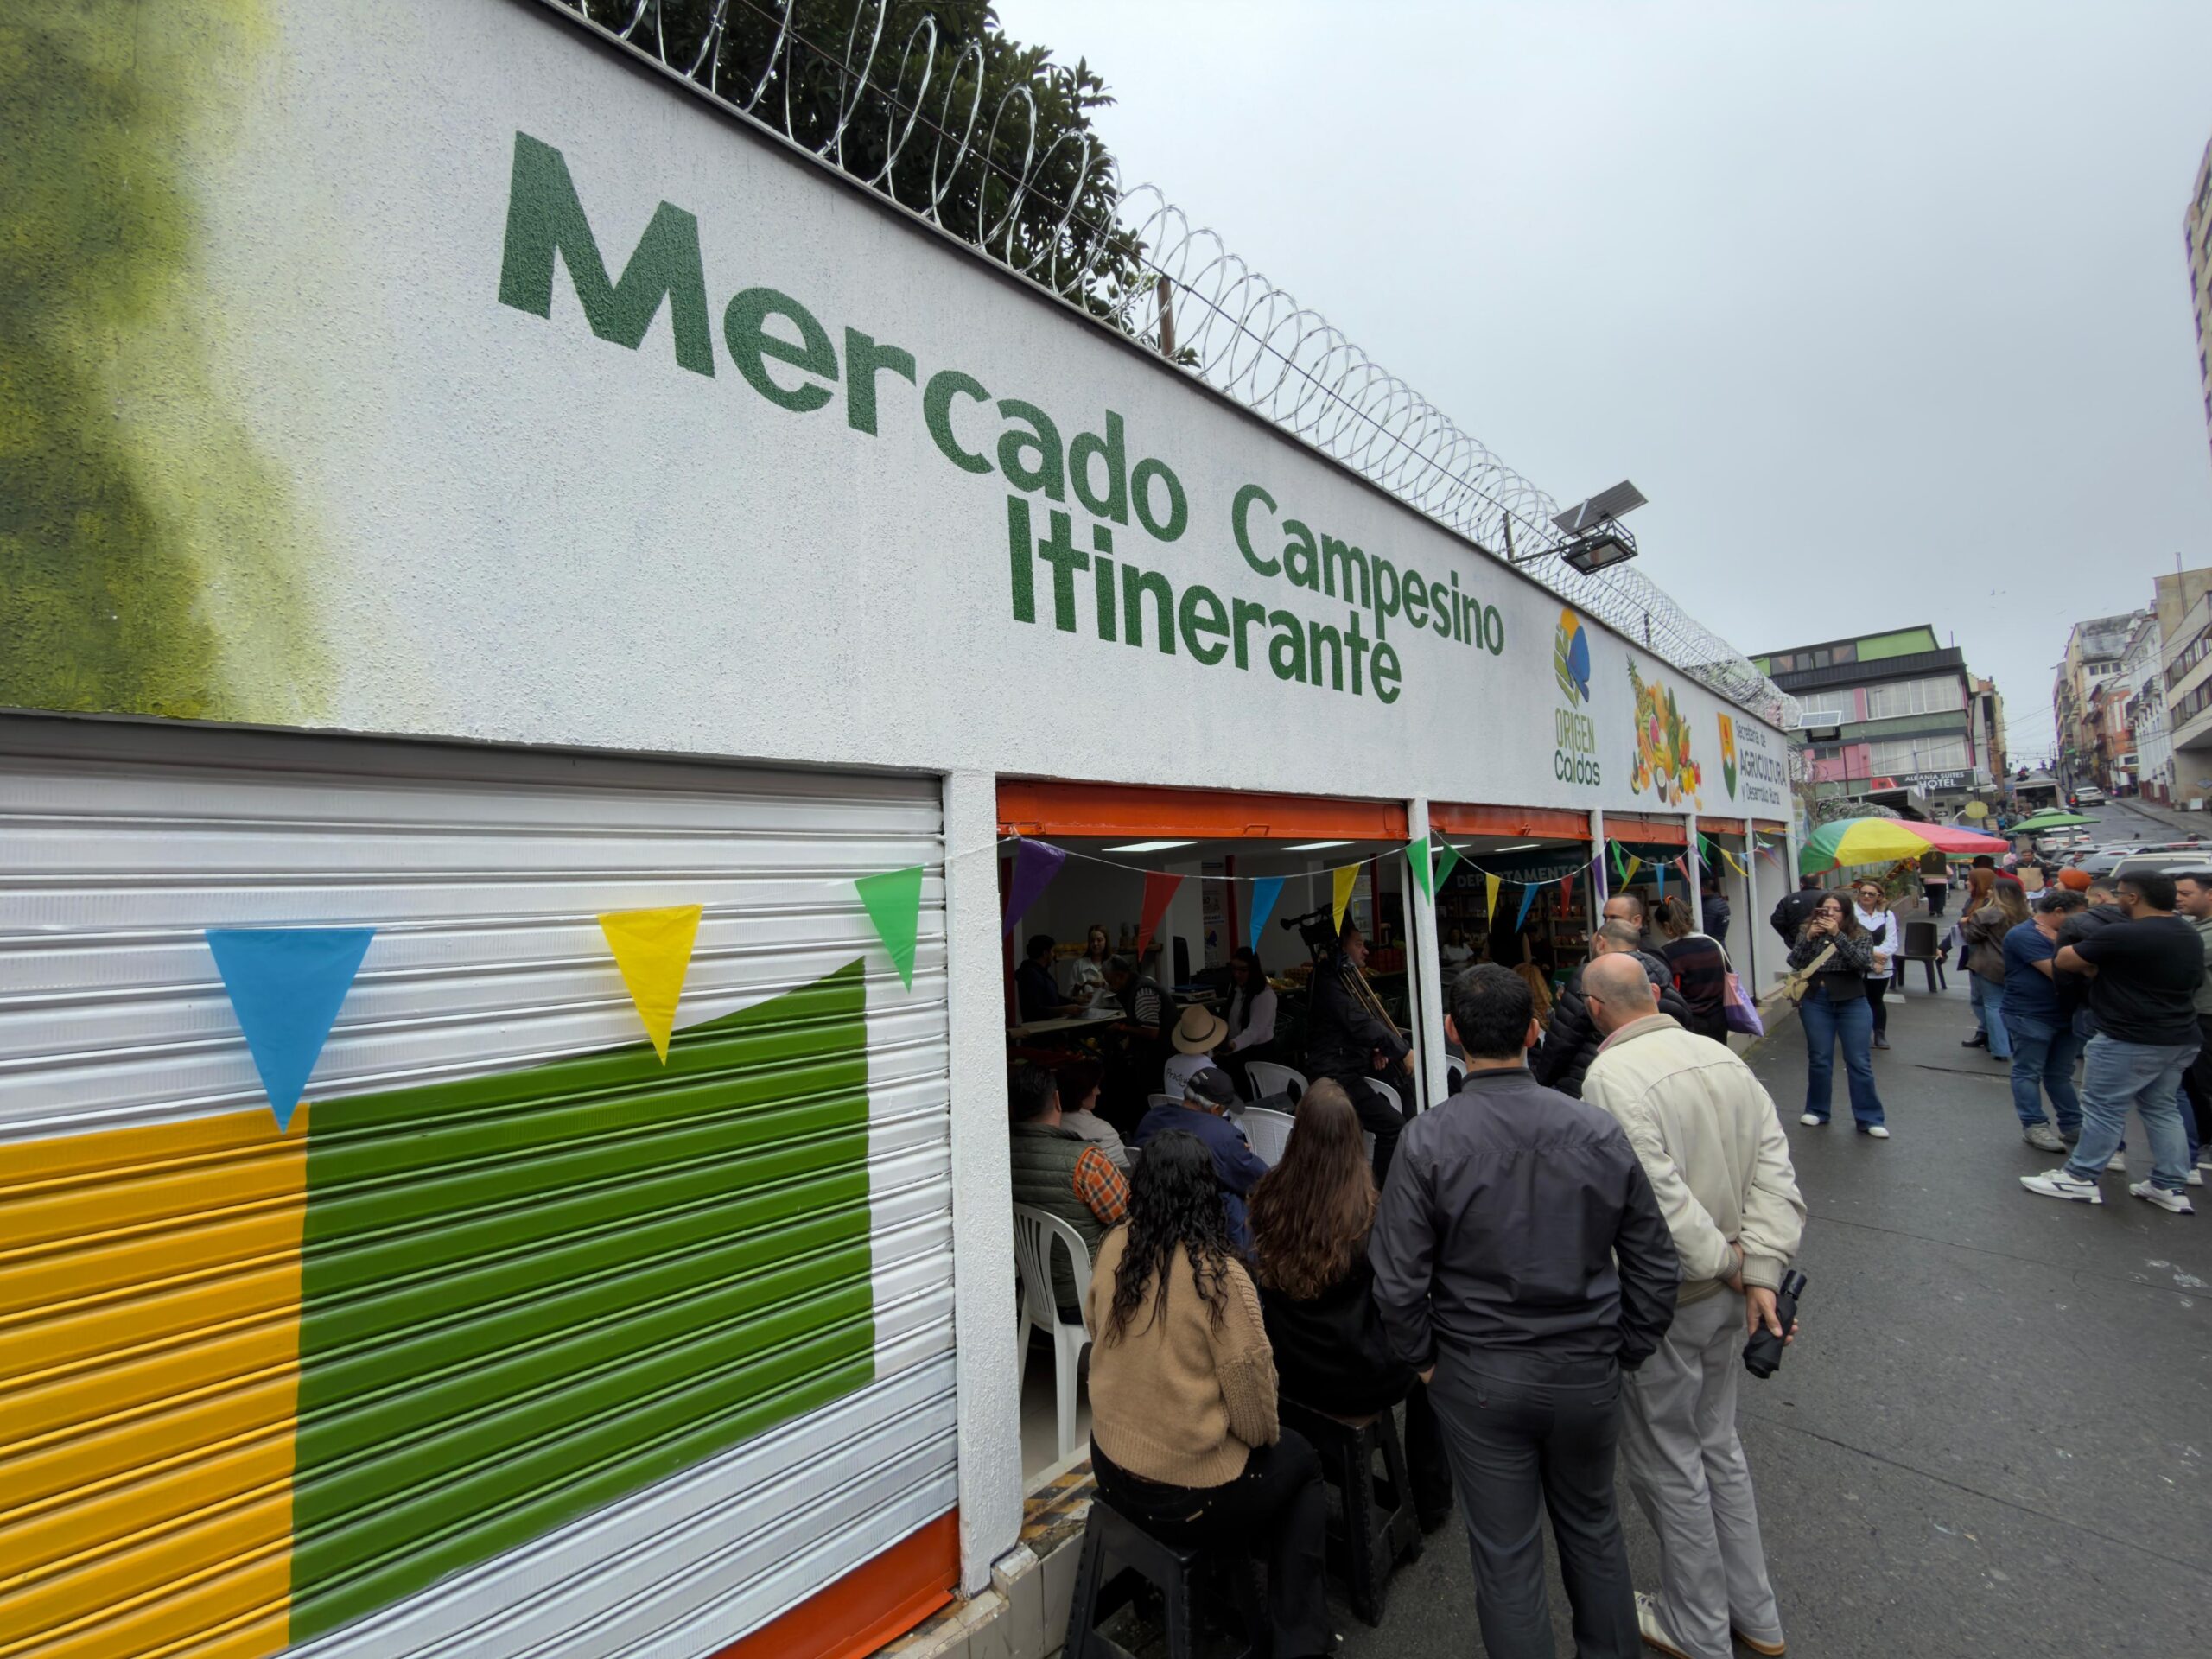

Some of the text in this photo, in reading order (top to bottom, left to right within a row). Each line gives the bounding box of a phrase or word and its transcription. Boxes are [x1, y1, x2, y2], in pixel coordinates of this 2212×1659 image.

[499, 130, 1504, 655] Mercado Campesino
[1007, 494, 1402, 704] Itinerante
[1555, 708, 1596, 754] ORIGEN
[1760, 731, 1767, 748] de
[1554, 749, 1601, 786] Caldas
[1739, 748, 1788, 787] AGRICULTURA
[1919, 779, 1956, 788] HOTEL
[1745, 782, 1770, 803] Desarrollo
[1456, 864, 1581, 888] DEPTAMENTO
